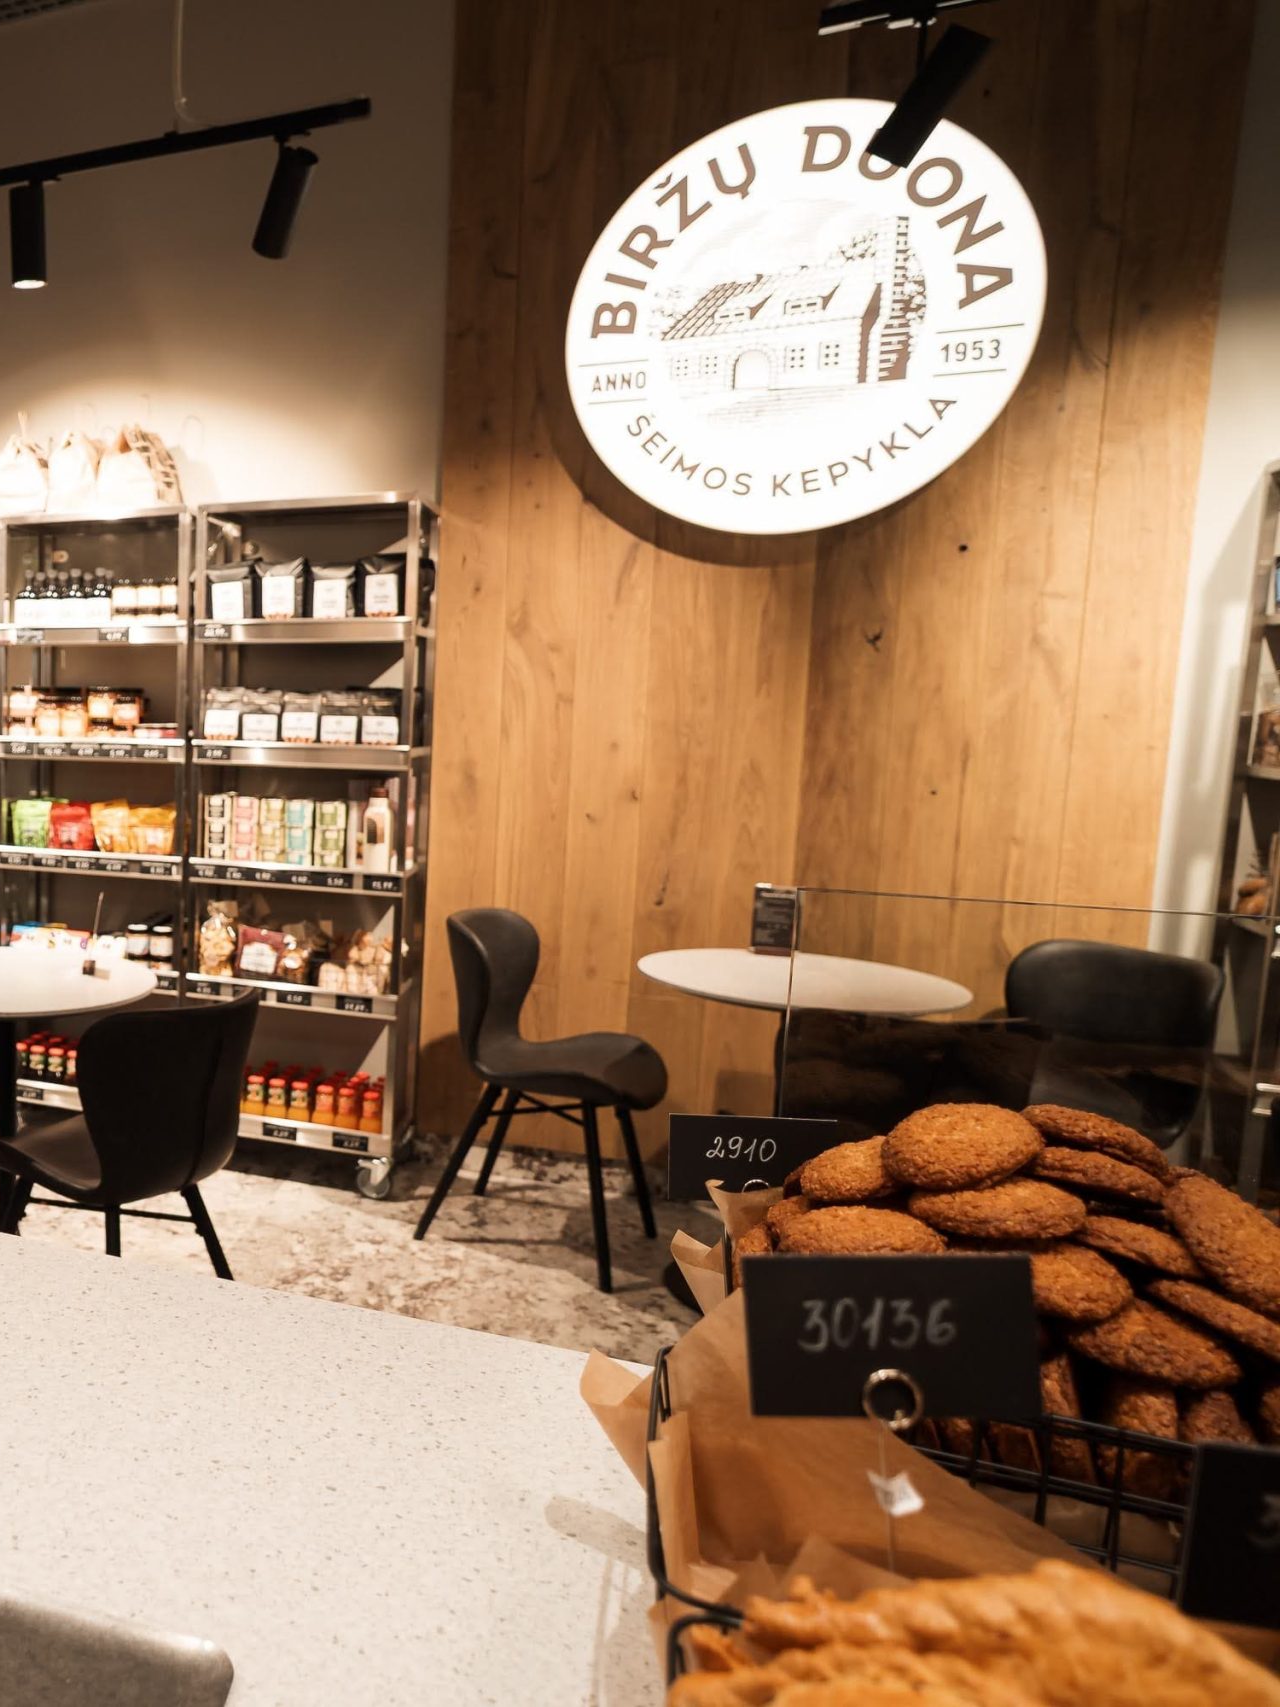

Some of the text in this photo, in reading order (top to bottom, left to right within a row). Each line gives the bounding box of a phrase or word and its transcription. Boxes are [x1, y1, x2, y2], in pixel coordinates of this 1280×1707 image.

[591, 142, 757, 339] BIRŽŲ
[939, 338, 1002, 363] 1953
[591, 371, 647, 393] ANNO
[772, 398, 958, 498] KEPYKLA
[705, 1136, 777, 1162] 2910
[797, 1297, 957, 1353] 30136
